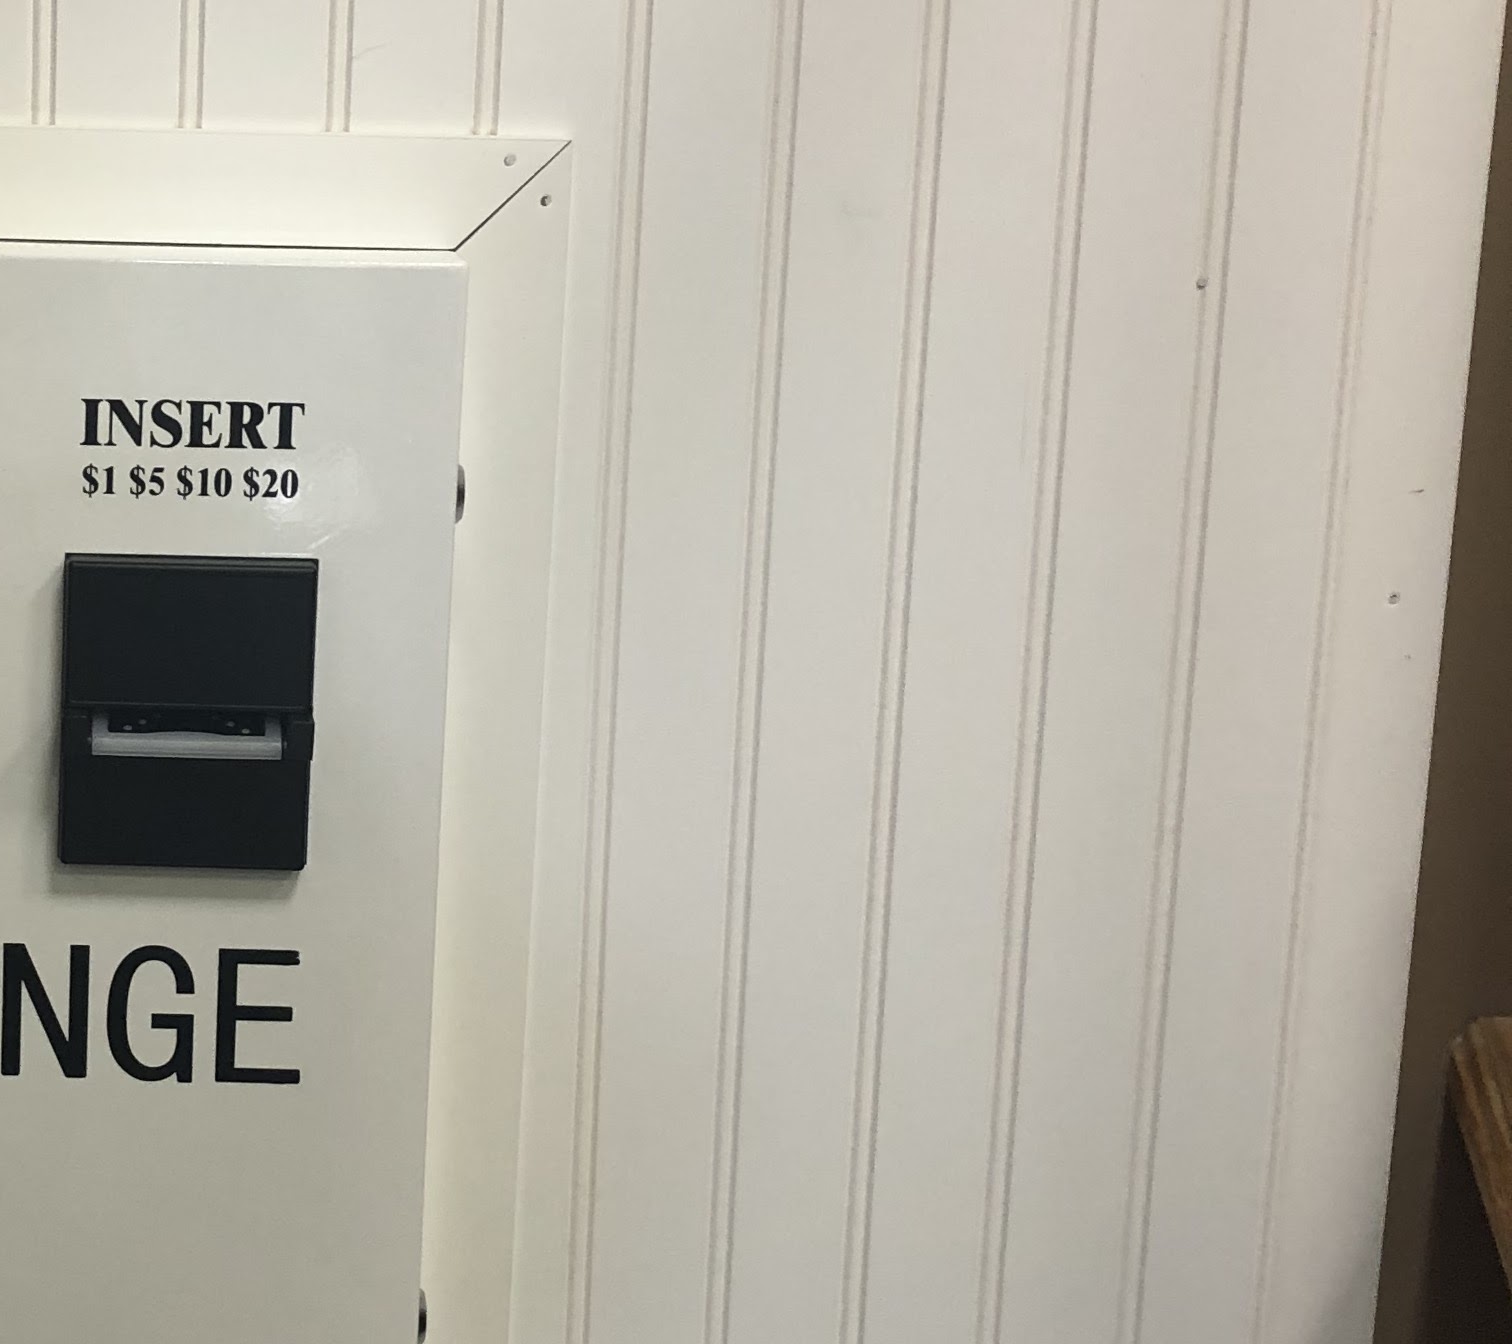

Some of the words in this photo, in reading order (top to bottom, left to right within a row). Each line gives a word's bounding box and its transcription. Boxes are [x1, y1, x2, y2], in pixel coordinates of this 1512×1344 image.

[79, 398, 305, 450] INSERT
[82, 464, 116, 497] $1
[129, 465, 165, 498] $5
[176, 466, 232, 499] $10
[243, 467, 299, 501] $20
